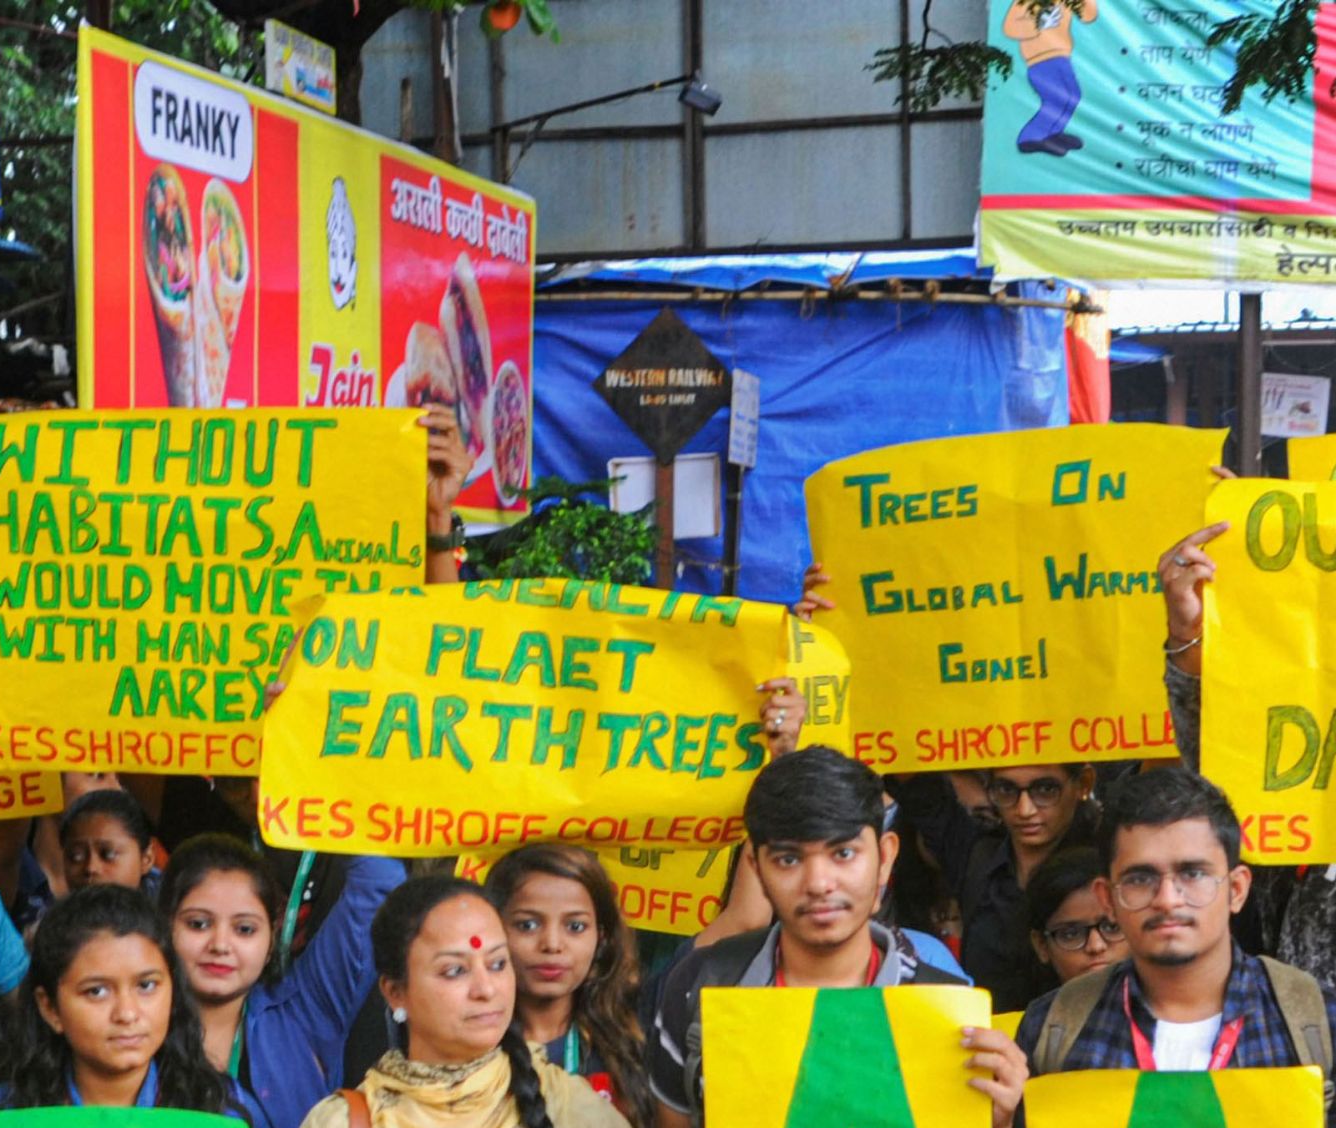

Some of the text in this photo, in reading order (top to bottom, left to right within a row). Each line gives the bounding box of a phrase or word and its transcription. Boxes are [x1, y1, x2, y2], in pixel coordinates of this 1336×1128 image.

[150, 85, 242, 161] FRANKY
[605, 368, 725, 388] WESTERN RAILWAY
[165, 562, 302, 617] MOVE
[136, 618, 229, 665] MAN
[301, 616, 656, 694] ON PLAET
[63, 729, 227, 769] SHROFF
[320, 689, 584, 773] EARTH
[596, 711, 766, 782] TREES
[915, 719, 1053, 775] SHROFF
[263, 796, 746, 849] KES SHROFF COLLEGE
